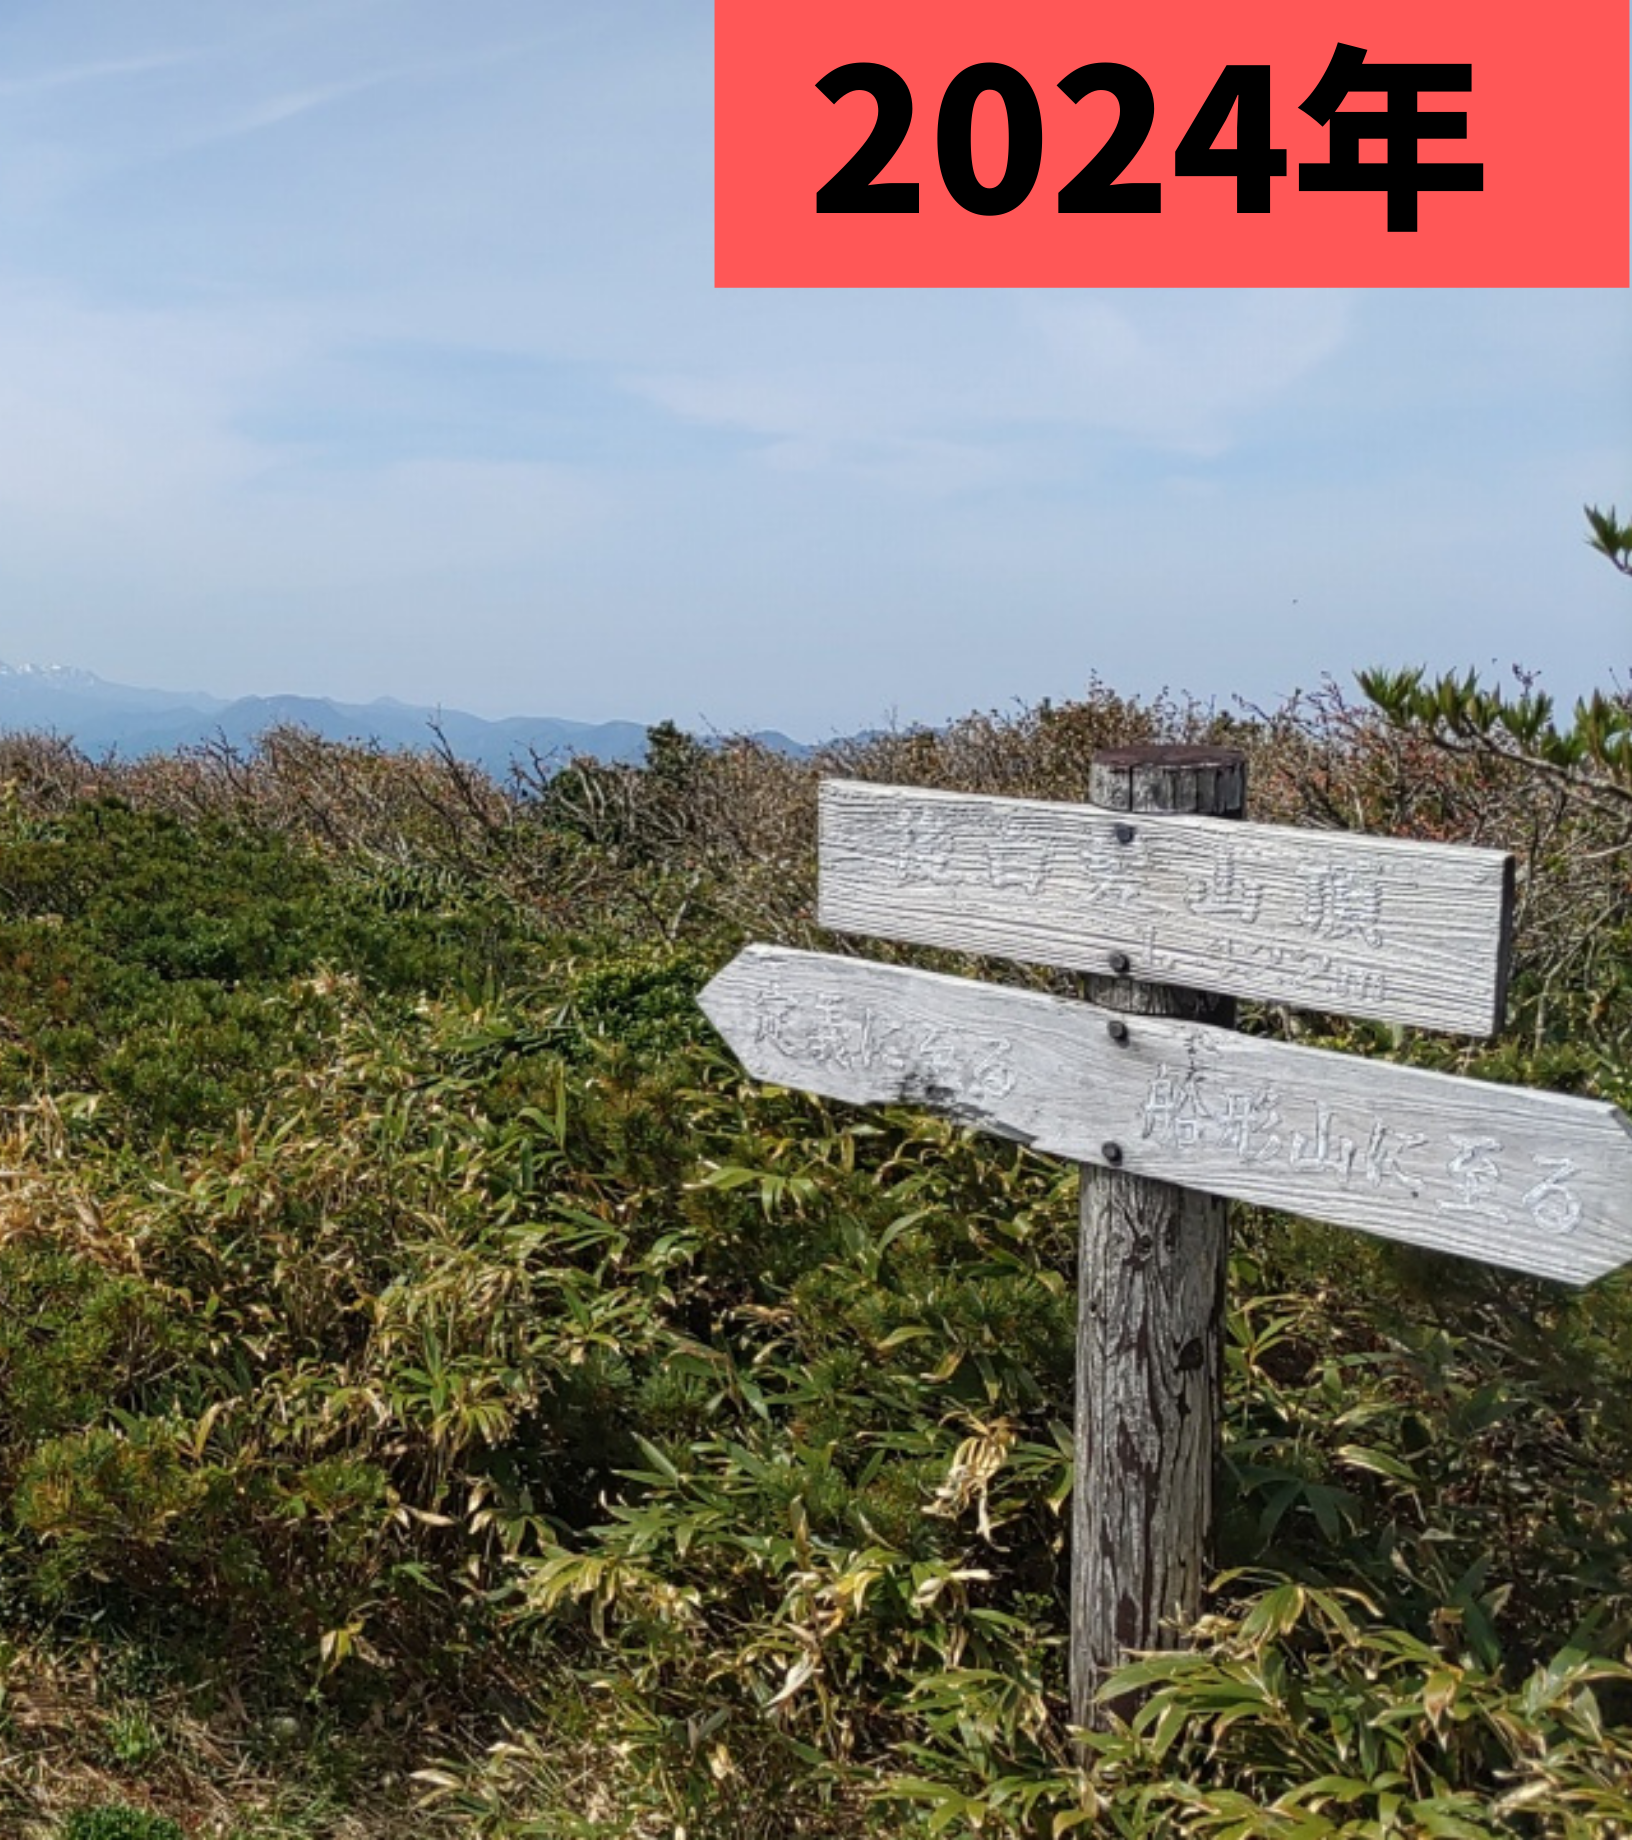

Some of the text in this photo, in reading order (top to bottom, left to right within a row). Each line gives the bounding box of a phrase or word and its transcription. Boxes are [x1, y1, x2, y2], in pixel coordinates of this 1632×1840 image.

[1141, 1062, 1582, 1234] 船形山に至る
